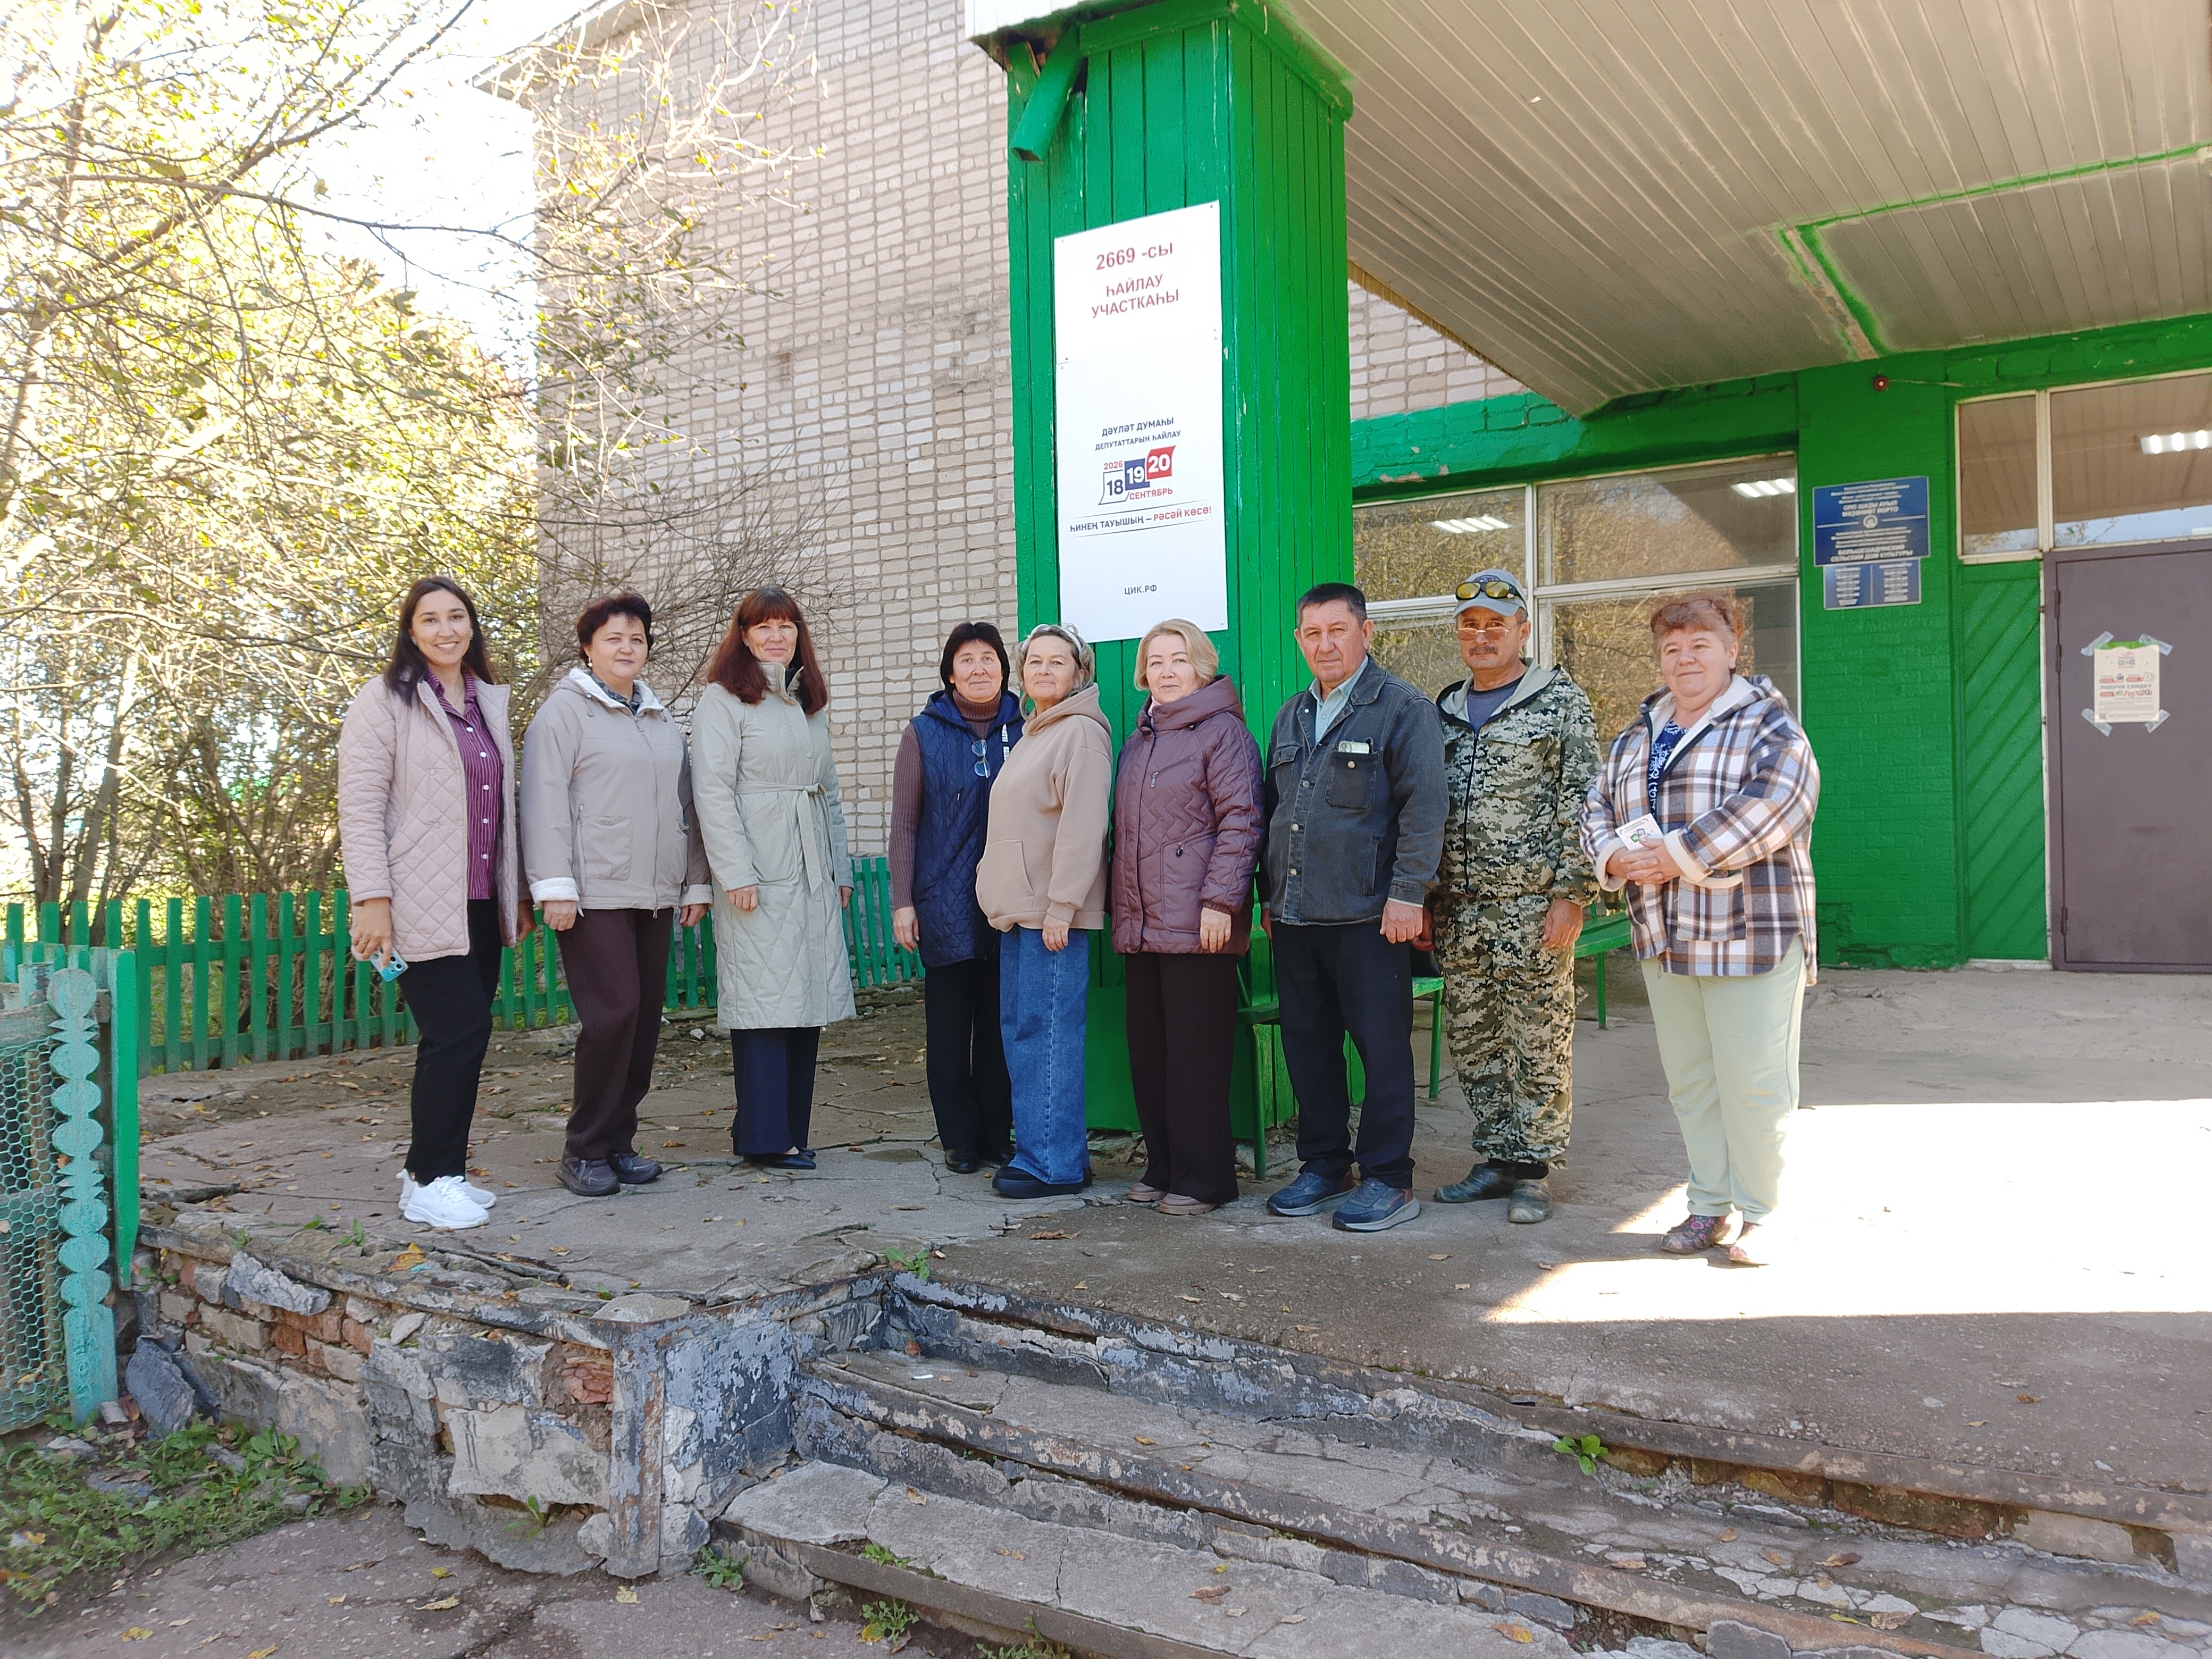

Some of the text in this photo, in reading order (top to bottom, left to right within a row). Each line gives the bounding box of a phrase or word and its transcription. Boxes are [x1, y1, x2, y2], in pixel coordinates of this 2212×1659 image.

[1096, 242, 1173, 270] 2669 -СЫ
[1095, 436, 1150, 451] ДЕПУТАТТАРЫН
[1103, 460, 1123, 470] 2026
[1107, 454, 1170, 496] 18 19 20
[1129, 488, 1174, 500] СЕНТЯБРЬ
[1100, 516, 1144, 529] ТАУЫШЫҢ
[1153, 508, 1183, 521] РӘСӘЙ
[1124, 584, 1157, 596] ЦИК.РФ
